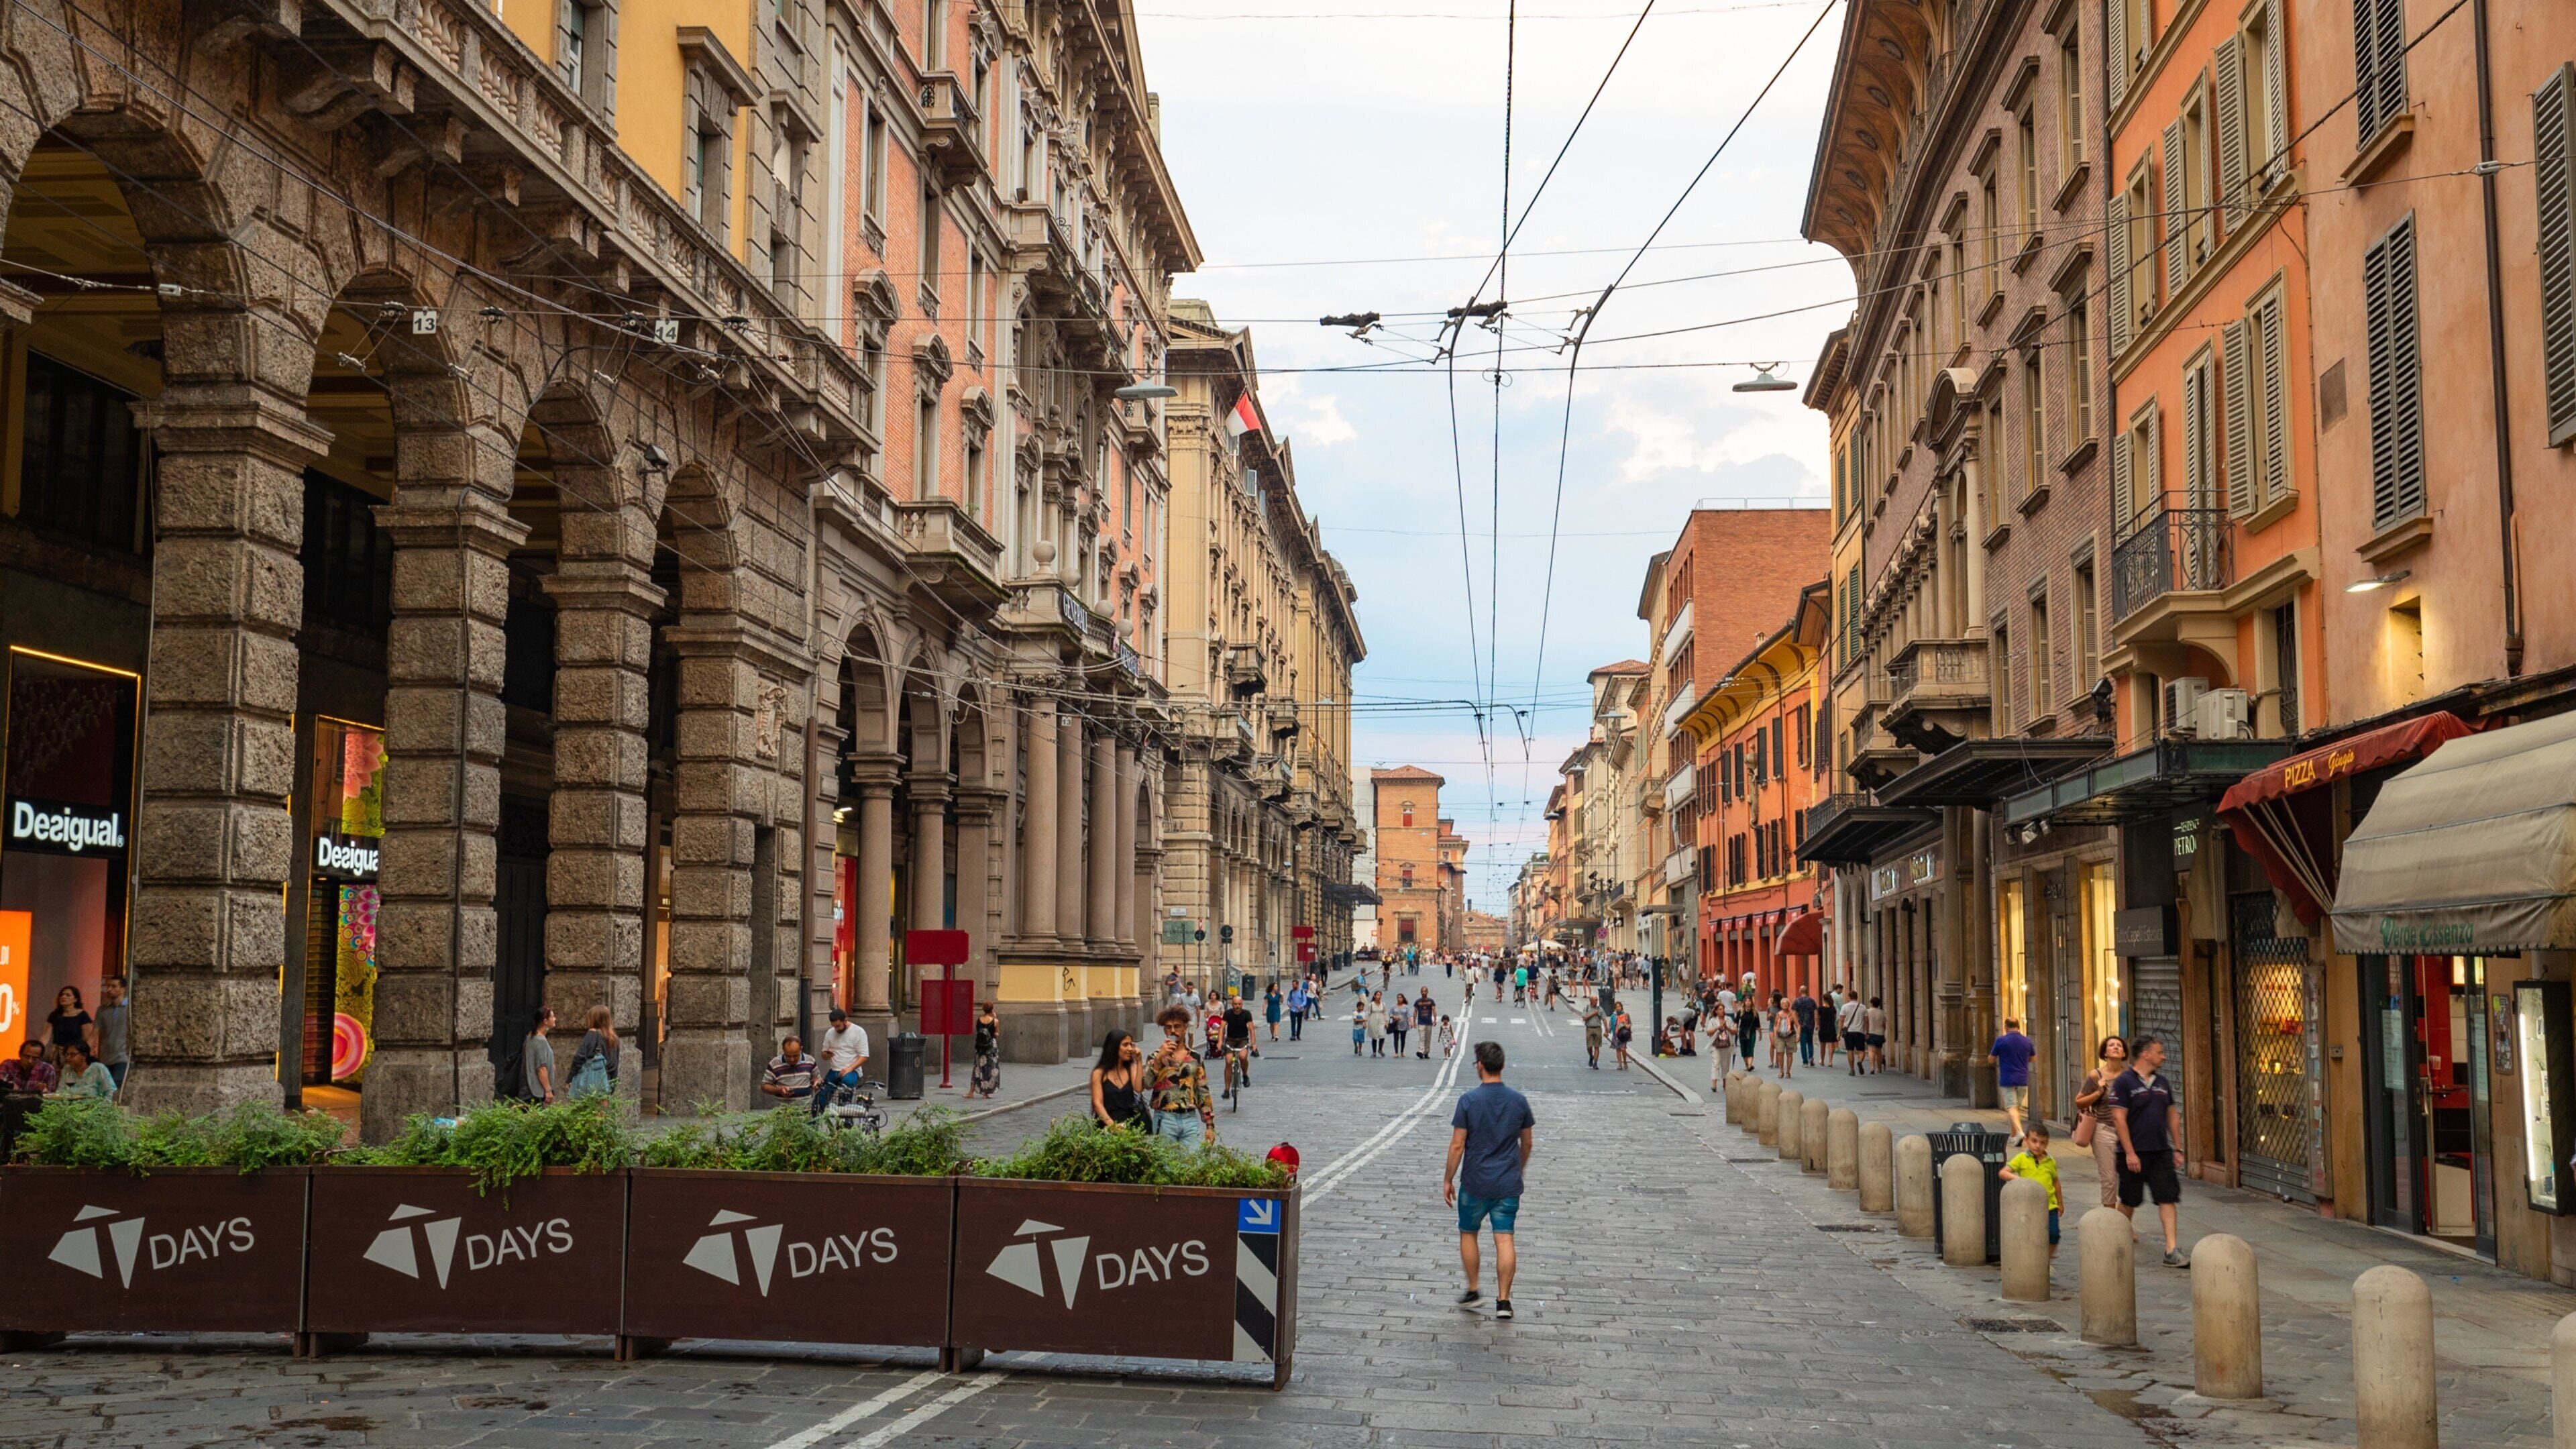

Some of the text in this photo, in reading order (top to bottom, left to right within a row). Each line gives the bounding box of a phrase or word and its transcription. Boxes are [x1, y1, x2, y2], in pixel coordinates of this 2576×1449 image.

[415, 318, 435, 331] 13
[656, 327, 677, 339] 14
[2285, 759, 2316, 788] PIZZA
[319, 837, 378, 876] Desigua
[2174, 835, 2197, 856] PETRO
[2381, 917, 2473, 948] Verde Essenza
[150, 1218, 254, 1269] DAYS
[466, 1219, 572, 1270] DAYS
[788, 1228, 897, 1277] DAYS
[1096, 1240, 1209, 1289] DAYS
